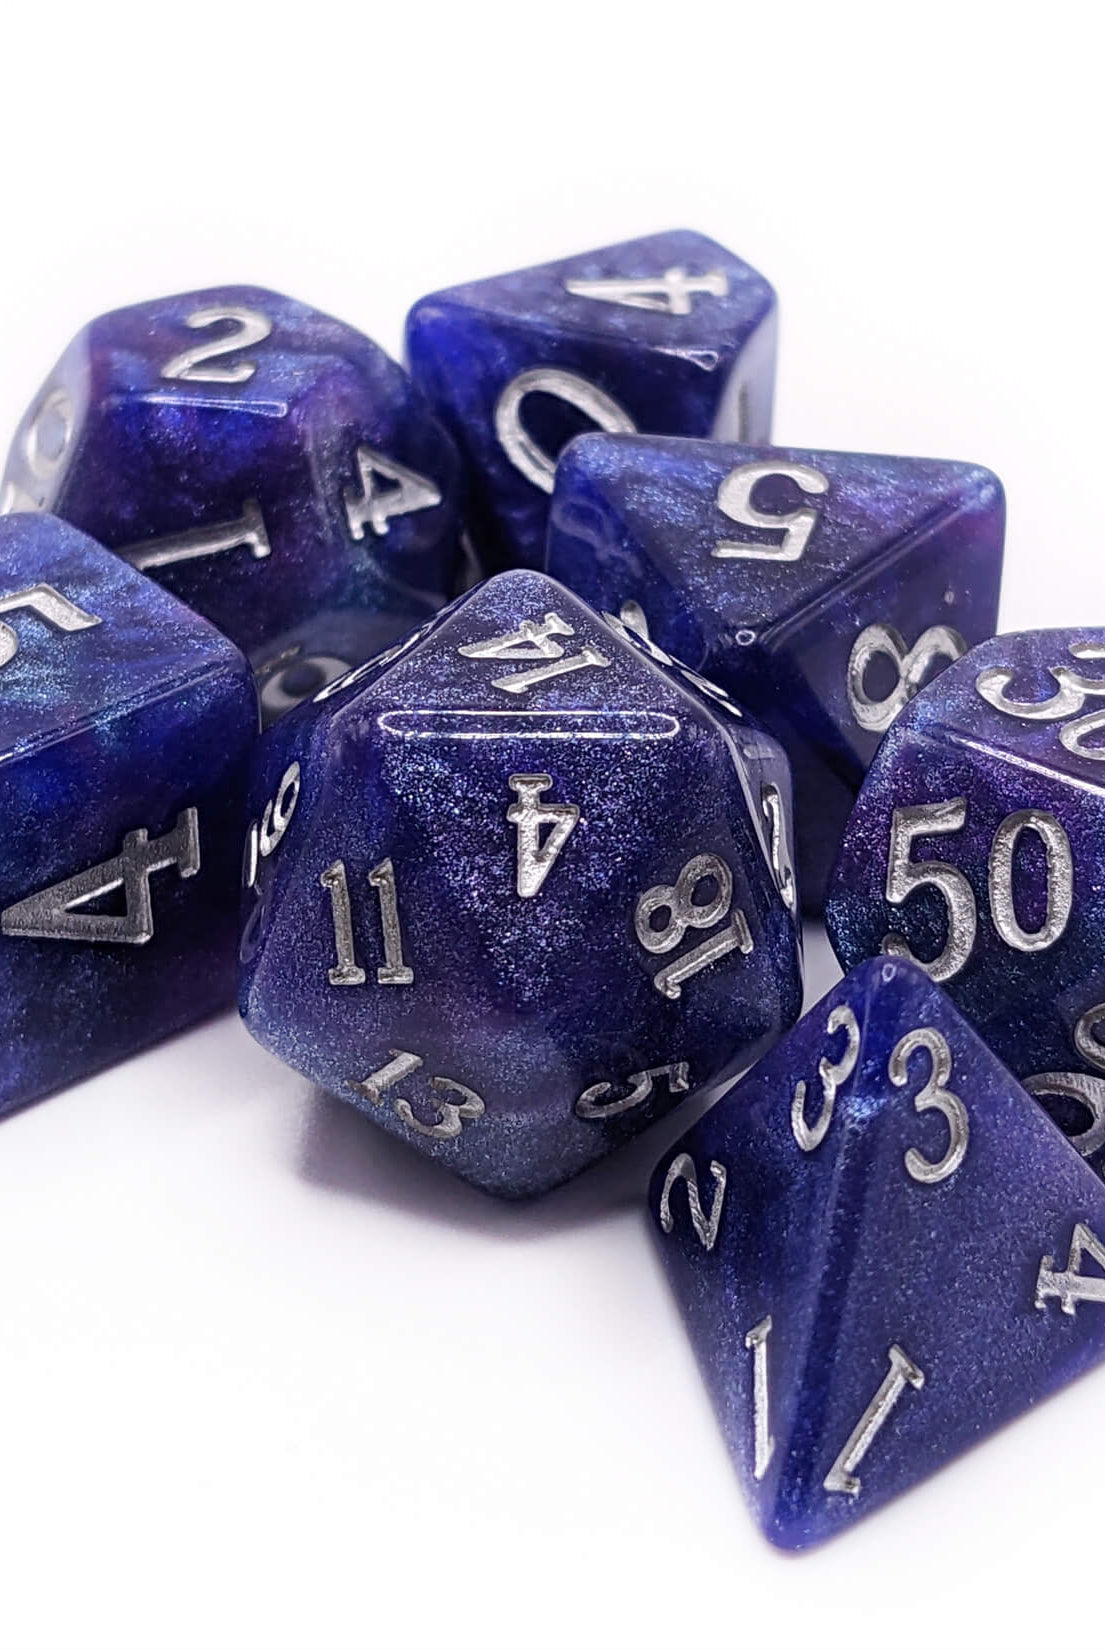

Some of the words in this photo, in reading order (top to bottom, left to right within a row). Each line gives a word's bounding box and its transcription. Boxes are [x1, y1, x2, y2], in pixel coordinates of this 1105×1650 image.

[162, 307, 272, 384] 2
[566, 267, 728, 315] 4
[345, 447, 441, 540] 4
[714, 462, 829, 561] 5
[458, 613, 611, 693] 14
[1, 807, 198, 944] 4
[505, 773, 580, 898] 4
[884, 799, 1073, 982] 50
[320, 858, 414, 985] 11
[635, 853, 755, 999] 18
[345, 1049, 485, 1138] 13
[575, 1061, 689, 1118] 5
[791, 1005, 860, 1151] 3
[888, 1027, 970, 1185] 3
[661, 1153, 727, 1251] 2
[746, 1315, 774, 1480] 1
[824, 1344, 924, 1496] 1
